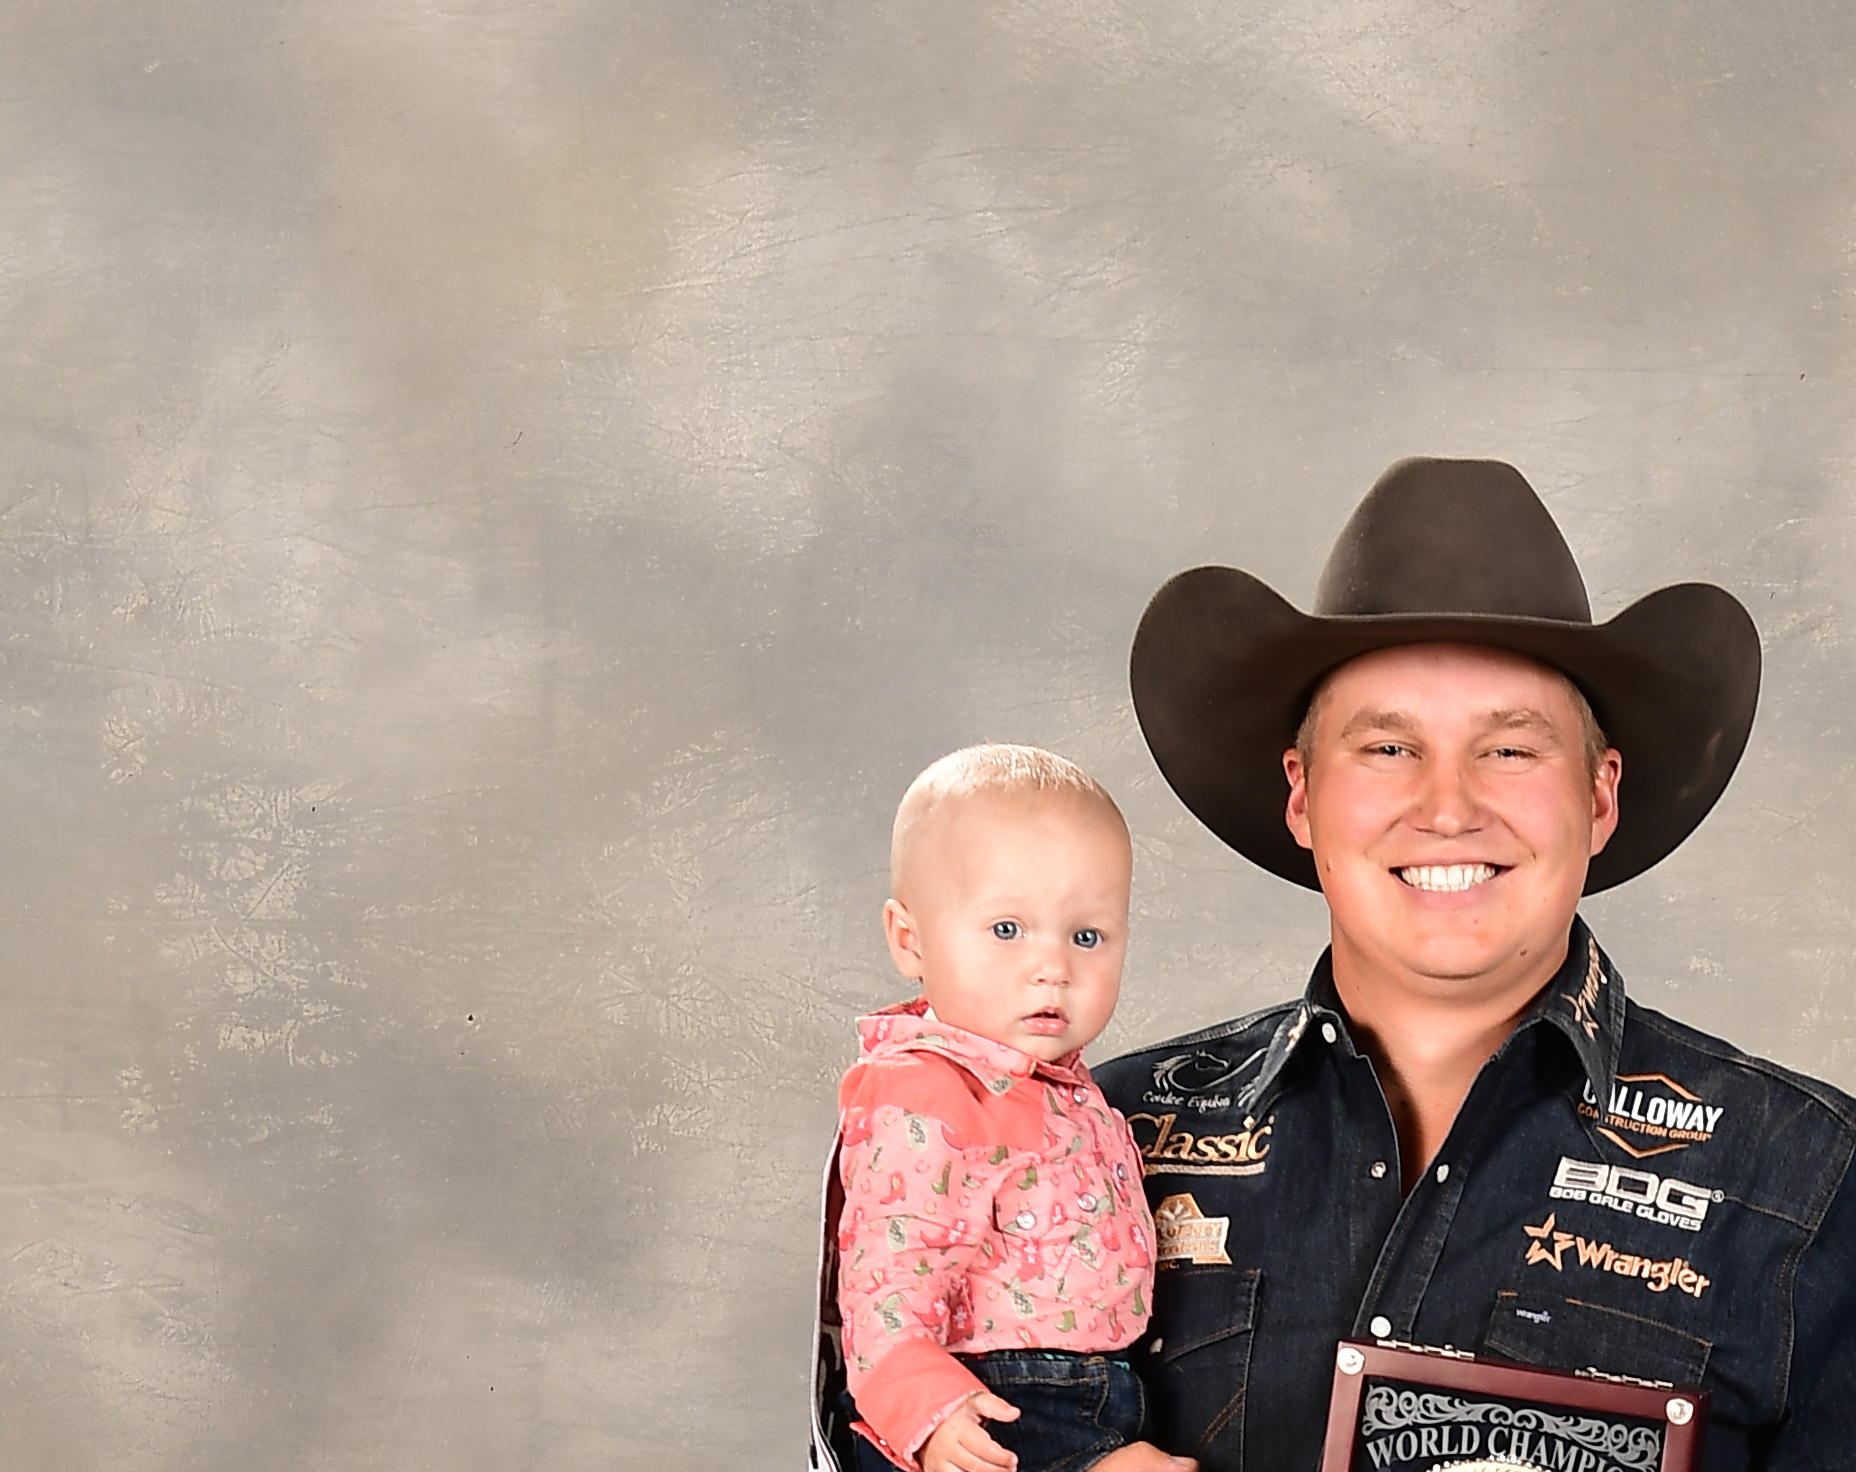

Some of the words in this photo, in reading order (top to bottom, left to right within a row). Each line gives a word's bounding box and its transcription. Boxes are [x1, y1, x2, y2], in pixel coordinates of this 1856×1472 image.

[1668, 1128, 1713, 1142] GROUP
[1549, 1186, 1587, 1201] BOB
[1589, 1193, 1633, 1213] DALE
[1636, 1206, 1703, 1232] GLOVES
[1576, 1237, 1711, 1299] Wrangler
[1366, 1424, 1481, 1470] WORLD
